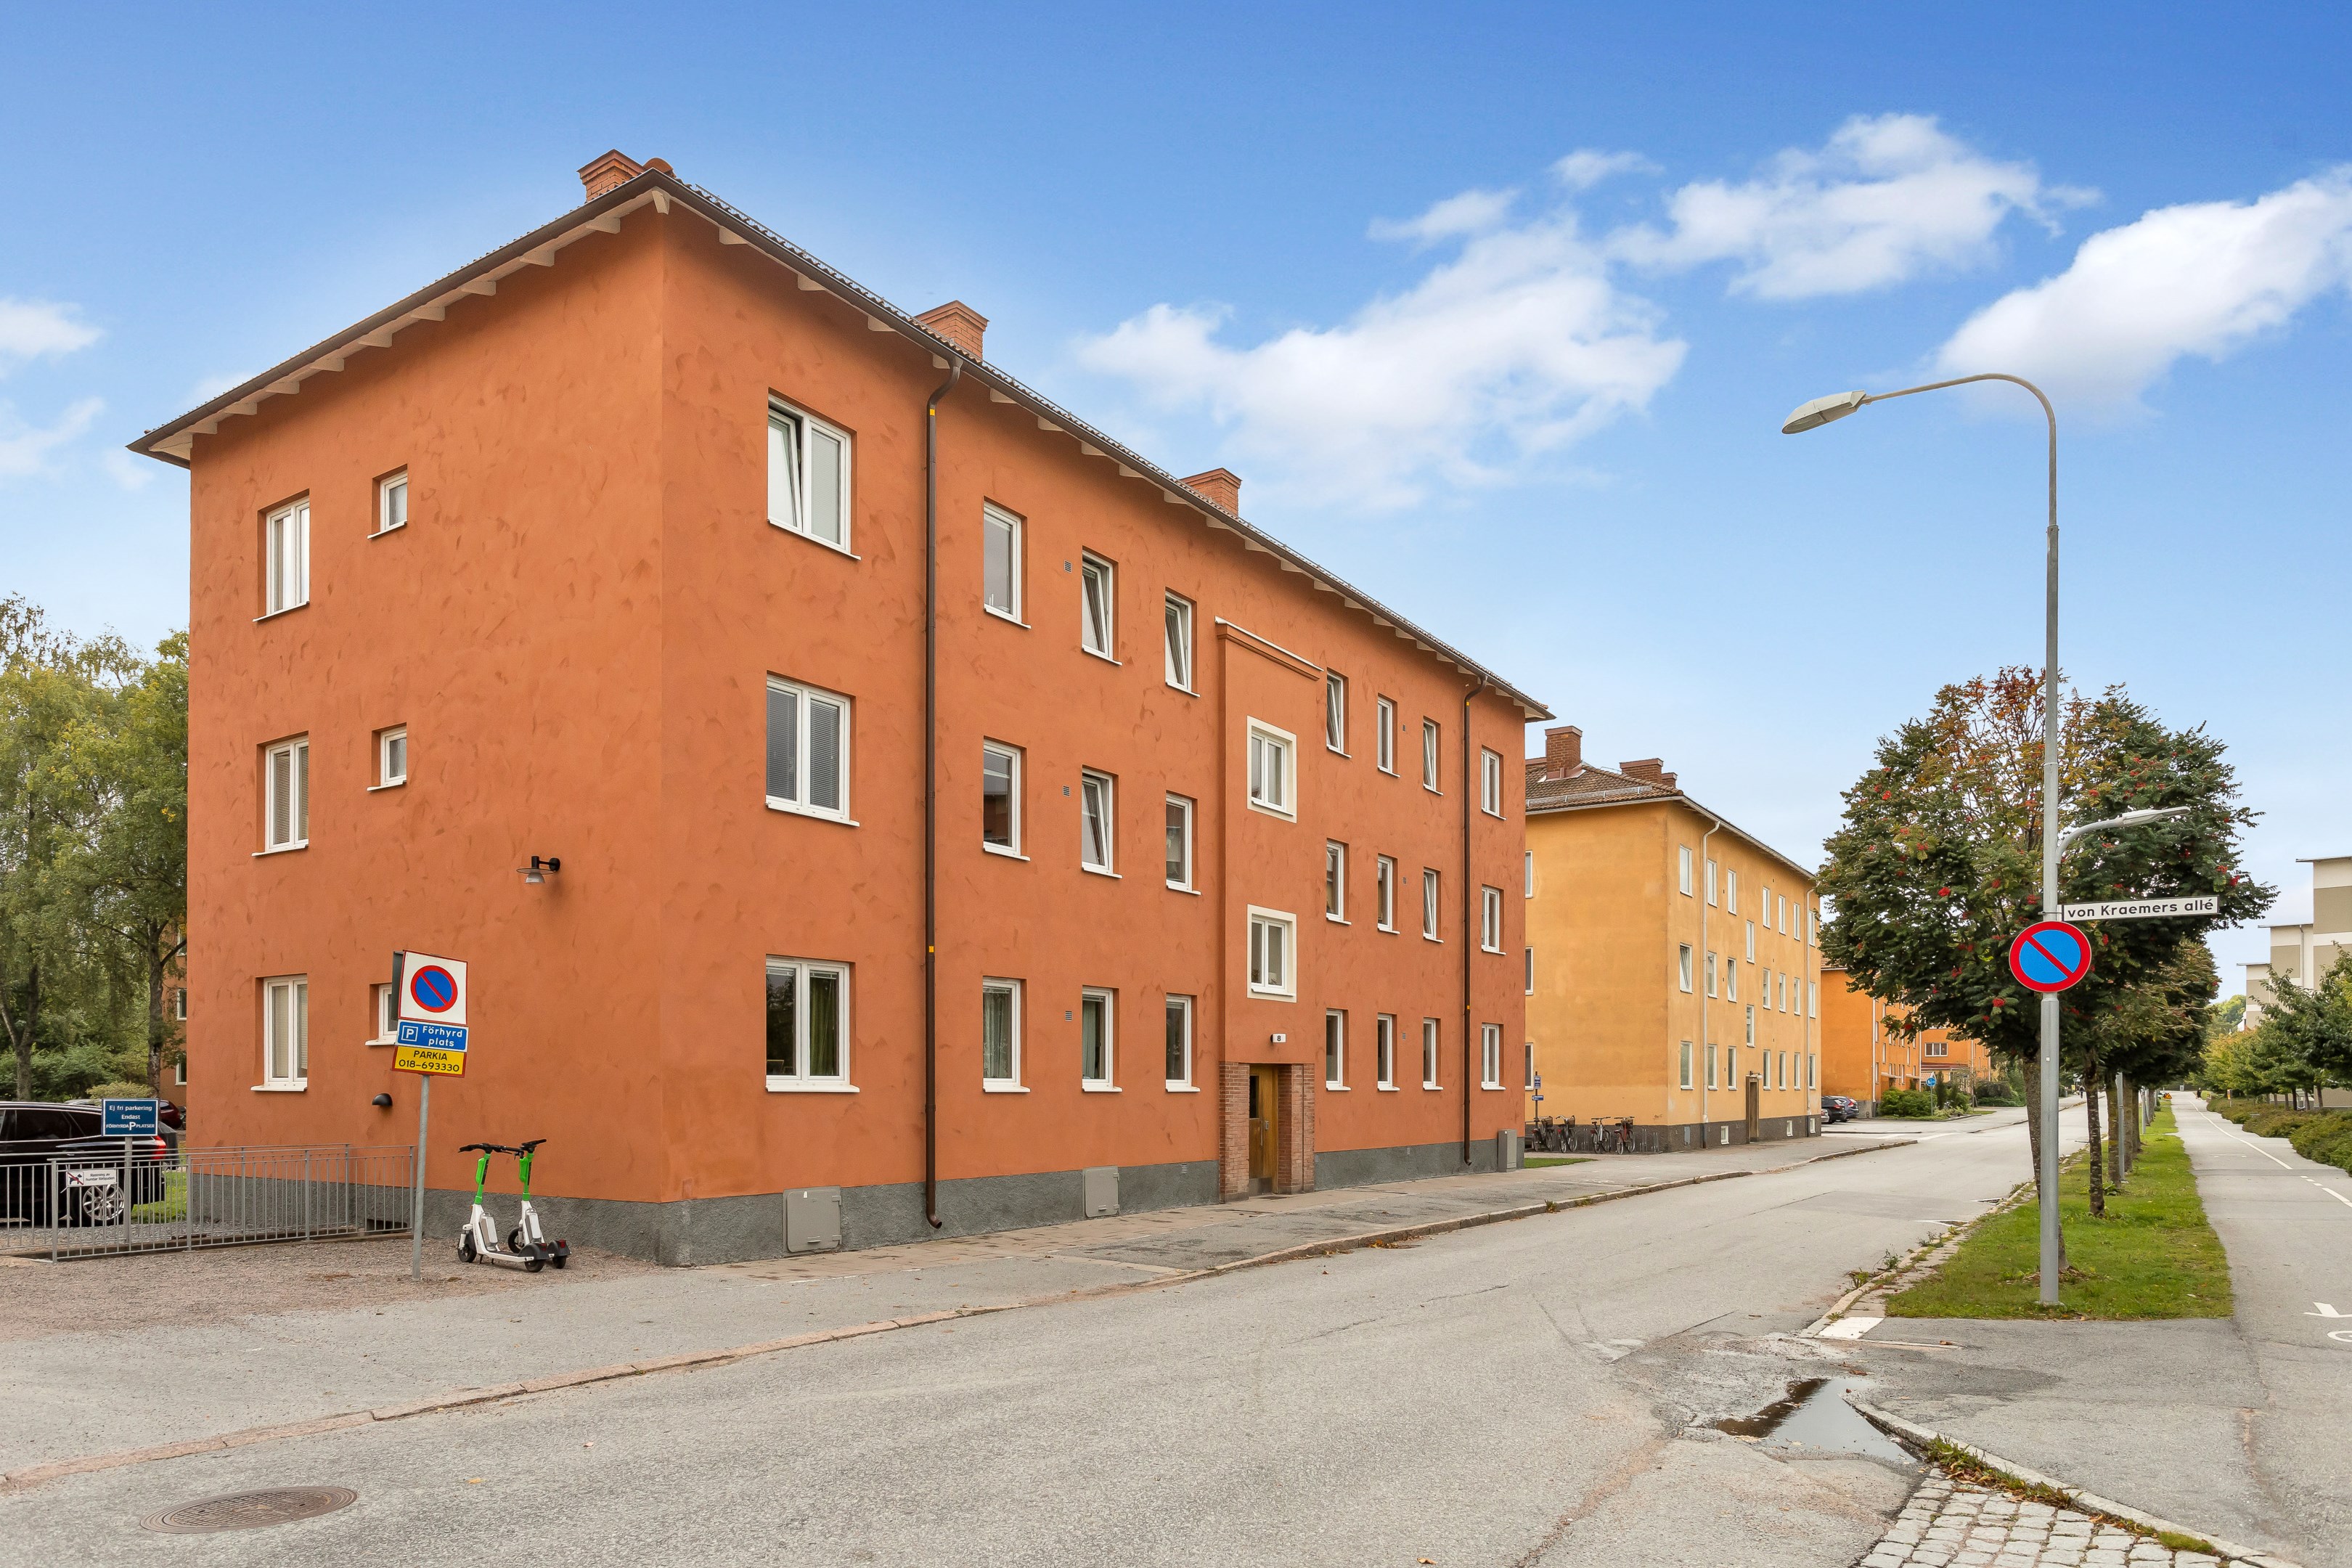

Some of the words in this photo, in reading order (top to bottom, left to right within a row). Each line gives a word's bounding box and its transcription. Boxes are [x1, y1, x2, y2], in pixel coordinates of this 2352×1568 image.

[2068, 908, 2095, 918] von
[2101, 903, 2178, 916] Kraemers
[2184, 899, 2214, 911] allé
[406, 1028, 415, 1039] P
[422, 1025, 463, 1038] Förhyrd
[428, 1037, 454, 1047] plats
[413, 1050, 448, 1061] PARKIA
[399, 1059, 460, 1071] 018-693330
